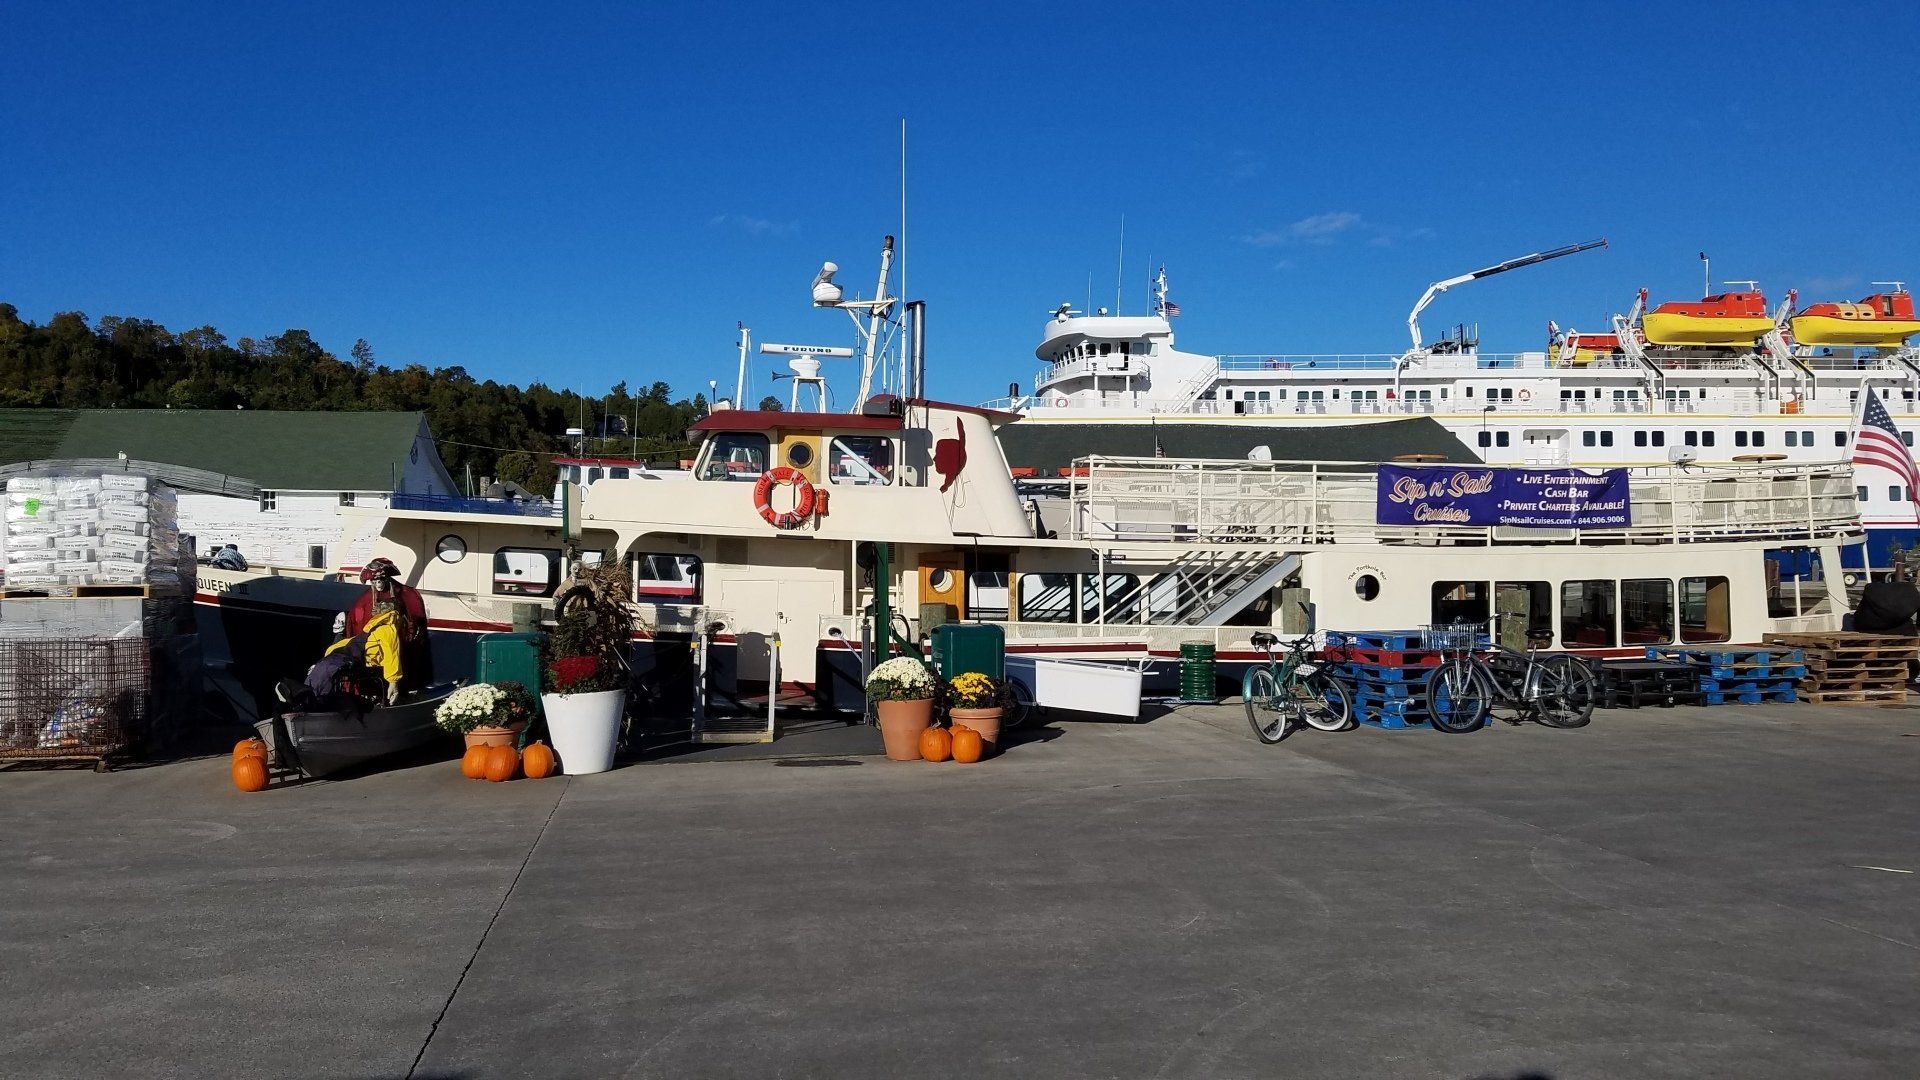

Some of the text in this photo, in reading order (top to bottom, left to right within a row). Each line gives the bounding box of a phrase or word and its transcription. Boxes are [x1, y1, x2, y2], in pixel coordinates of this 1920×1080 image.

[1388, 476, 1428, 505] Sip
[1447, 470, 1494, 498] Sail
[1413, 502, 1471, 522] Cruises
[1499, 515, 1625, 525] SipNsailCruises.com 844.906.9006
[198, 577, 233, 593] QUEEN
